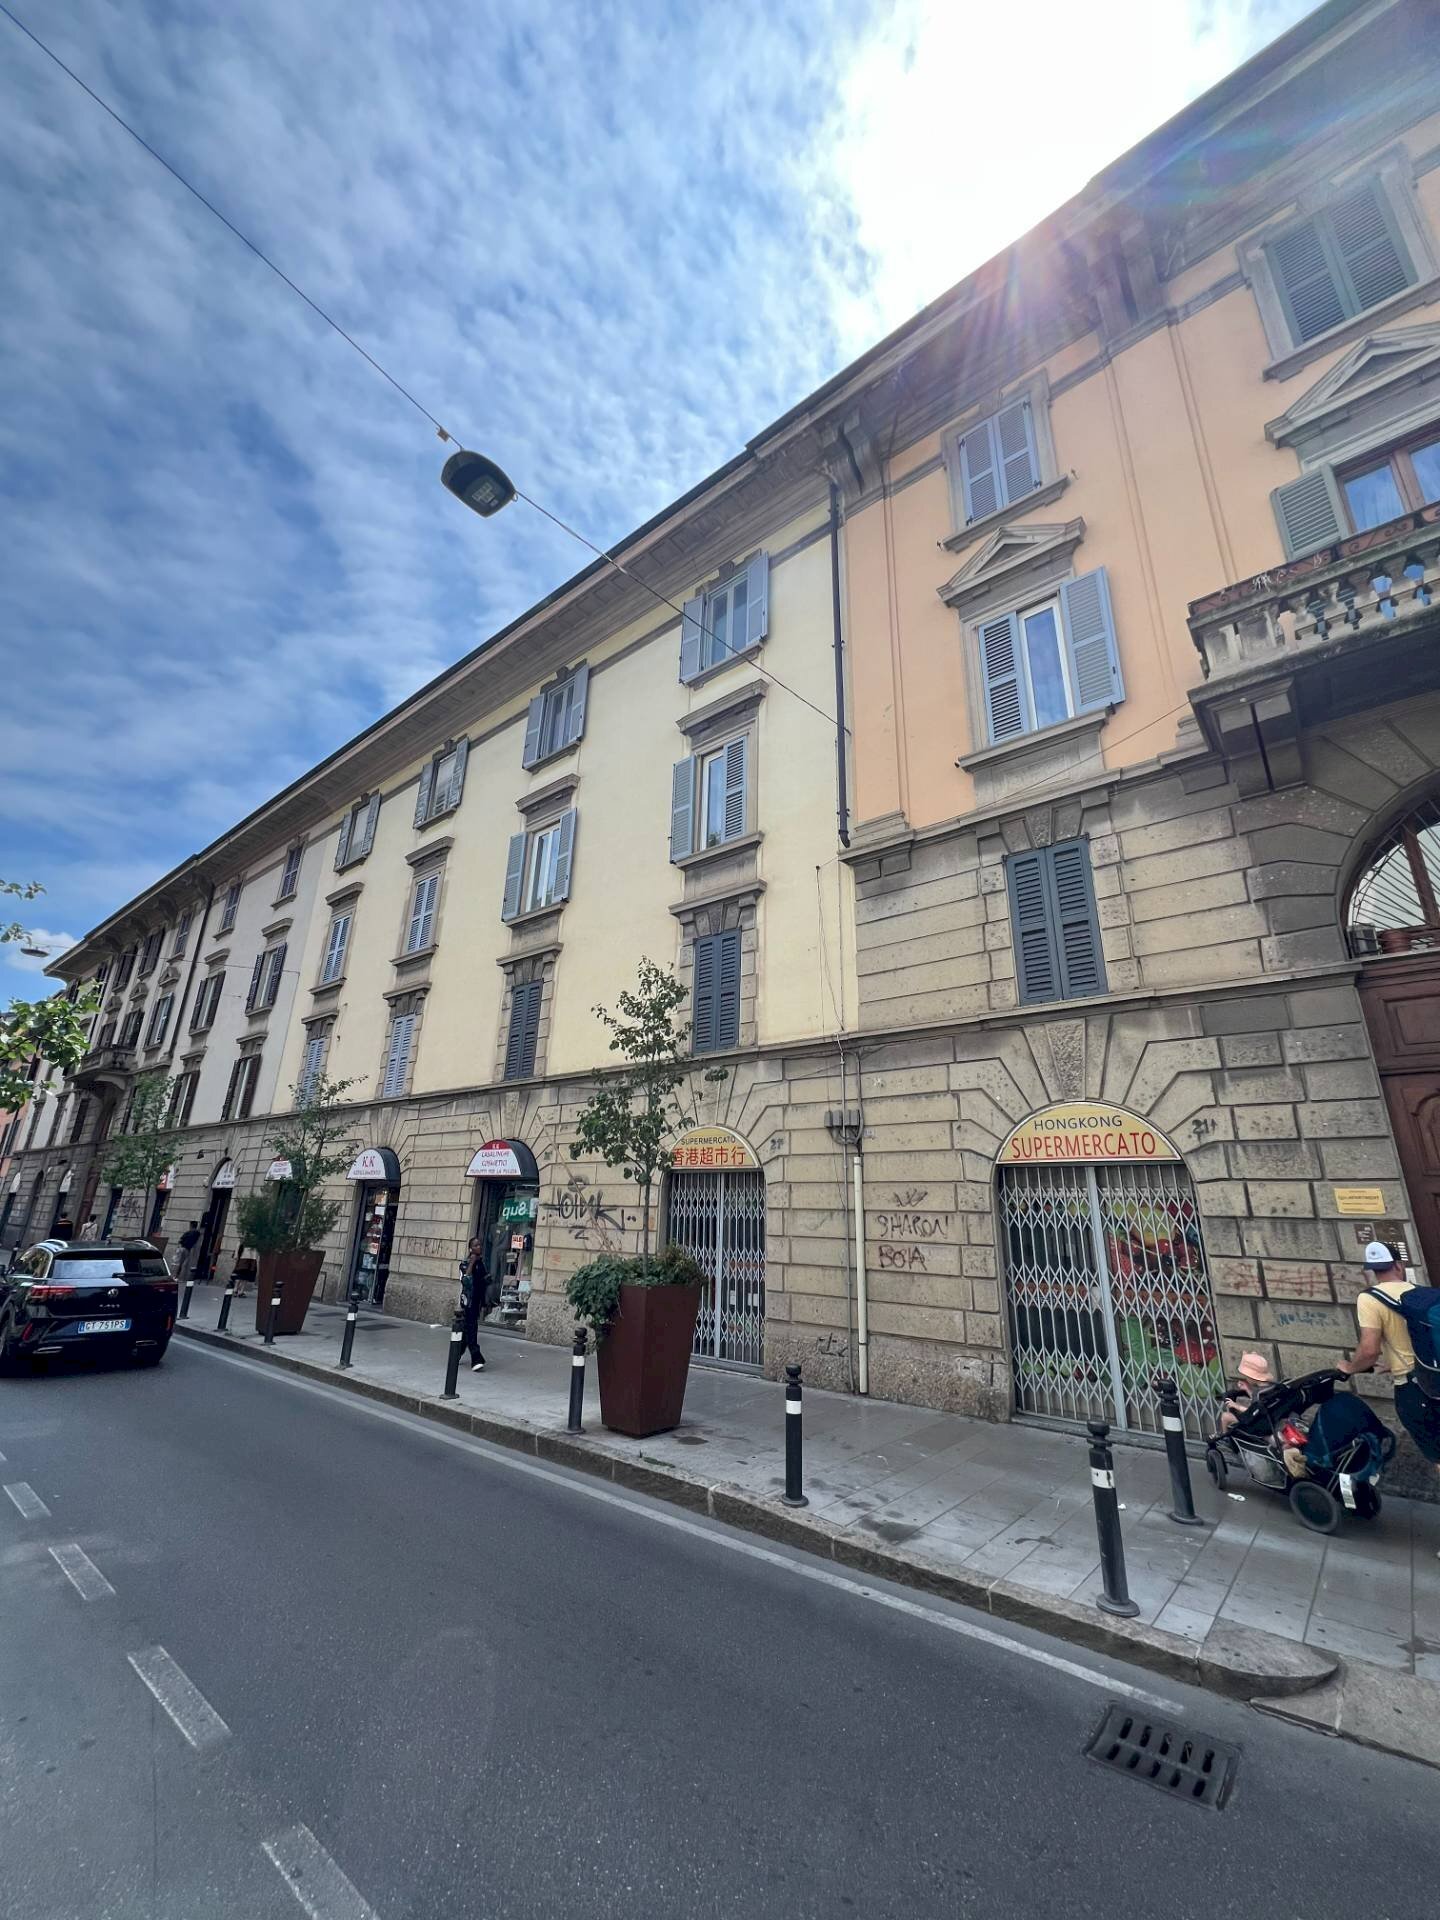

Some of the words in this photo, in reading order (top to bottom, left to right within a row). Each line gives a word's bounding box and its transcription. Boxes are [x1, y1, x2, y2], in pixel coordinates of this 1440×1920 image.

[1034, 1115, 1123, 1131] HONGKONG
[681, 1135, 736, 1146] SUPERMERCATO
[1011, 1131, 1156, 1159] SUPERMERCATO
[673, 1145, 746, 1166] 香港超市行
